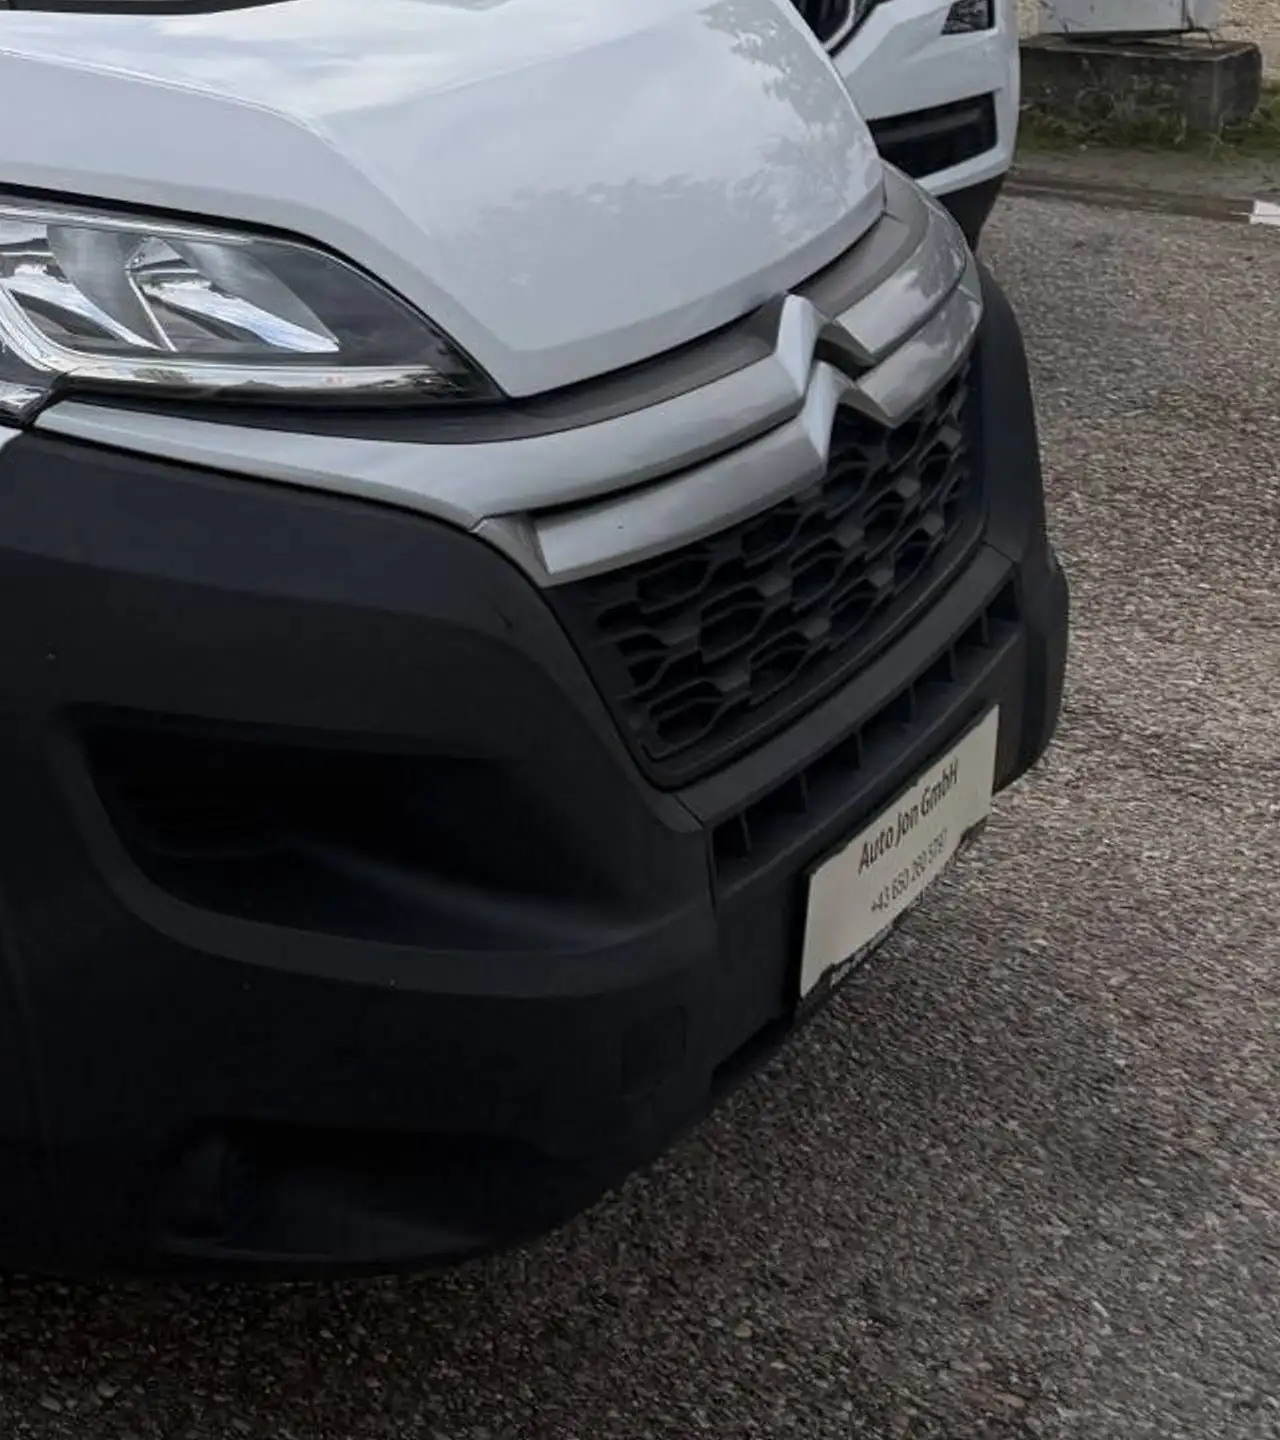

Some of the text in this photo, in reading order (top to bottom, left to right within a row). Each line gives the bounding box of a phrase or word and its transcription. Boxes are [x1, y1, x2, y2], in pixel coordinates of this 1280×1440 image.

[858, 757, 959, 874] Auto Jon GmbH
